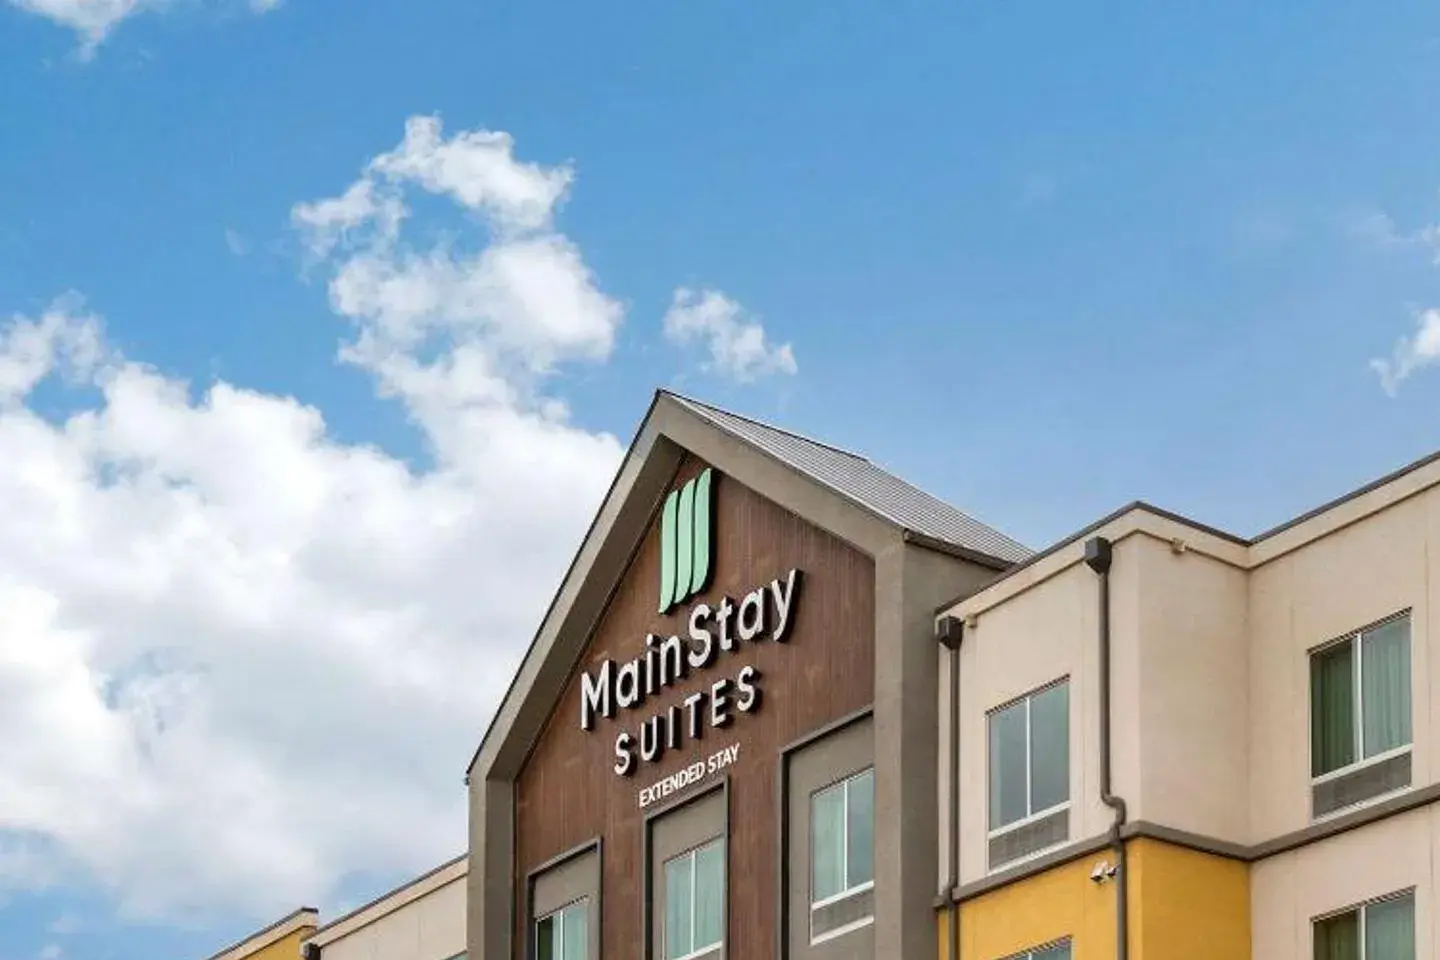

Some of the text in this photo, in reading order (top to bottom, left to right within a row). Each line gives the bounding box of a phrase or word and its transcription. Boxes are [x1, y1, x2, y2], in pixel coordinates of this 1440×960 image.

[580, 568, 803, 730] MainStay
[614, 665, 760, 776] SUITES
[639, 743, 740, 808] EXTENDED STAY
